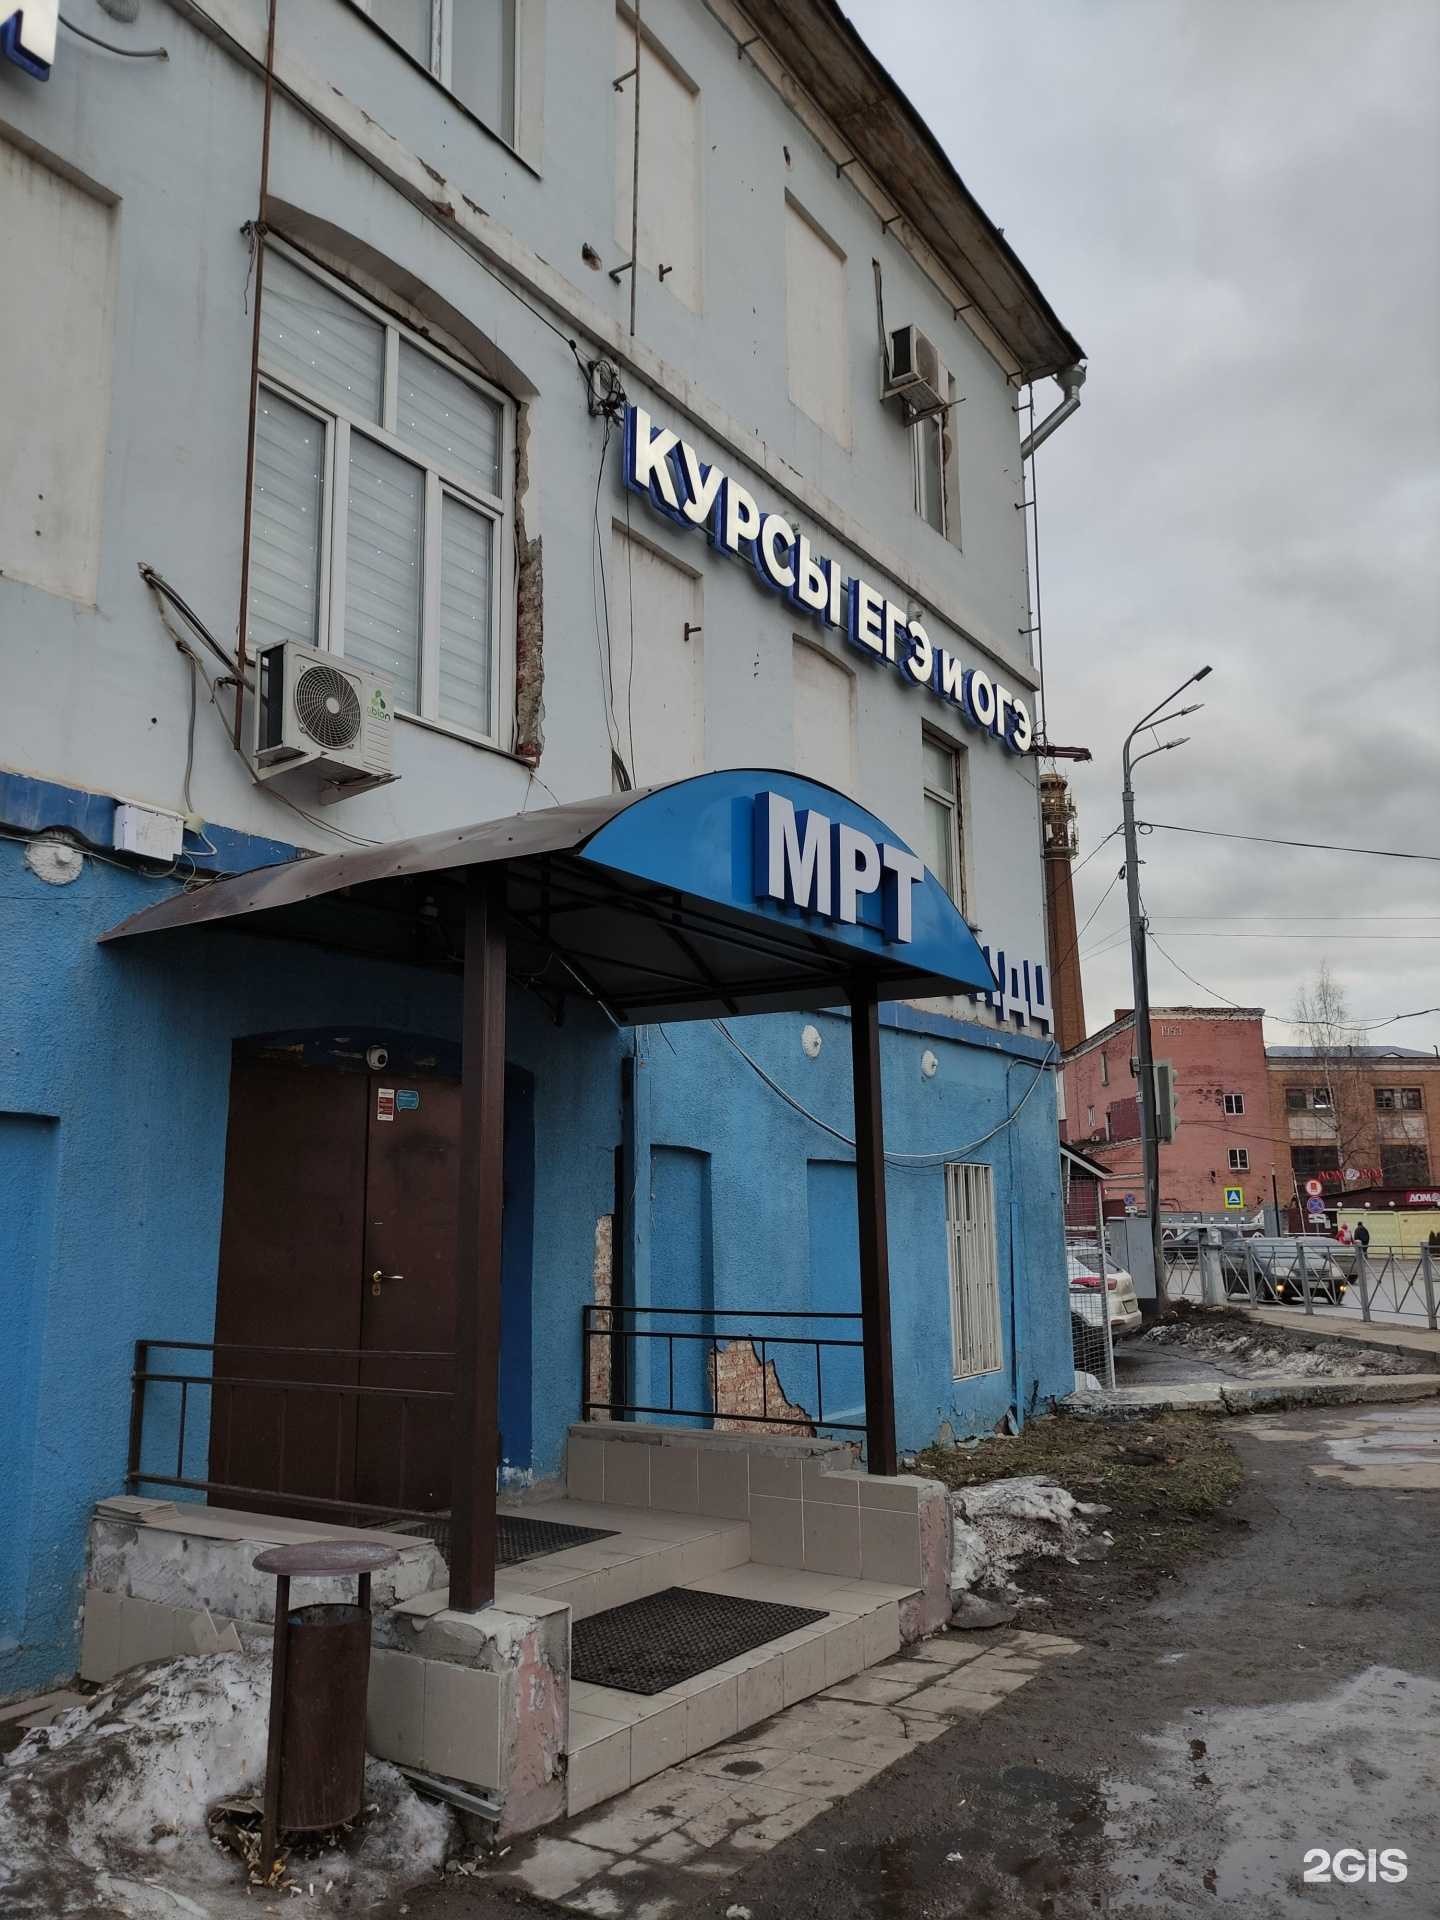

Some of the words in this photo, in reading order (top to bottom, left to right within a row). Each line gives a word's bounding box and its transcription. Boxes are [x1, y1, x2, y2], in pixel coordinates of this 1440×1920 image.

[629, 405, 840, 628] КУРСЫ
[853, 578, 933, 685] ЕГЭ
[968, 669, 1032, 753] ОГЭ
[760, 791, 925, 944] МРТ
